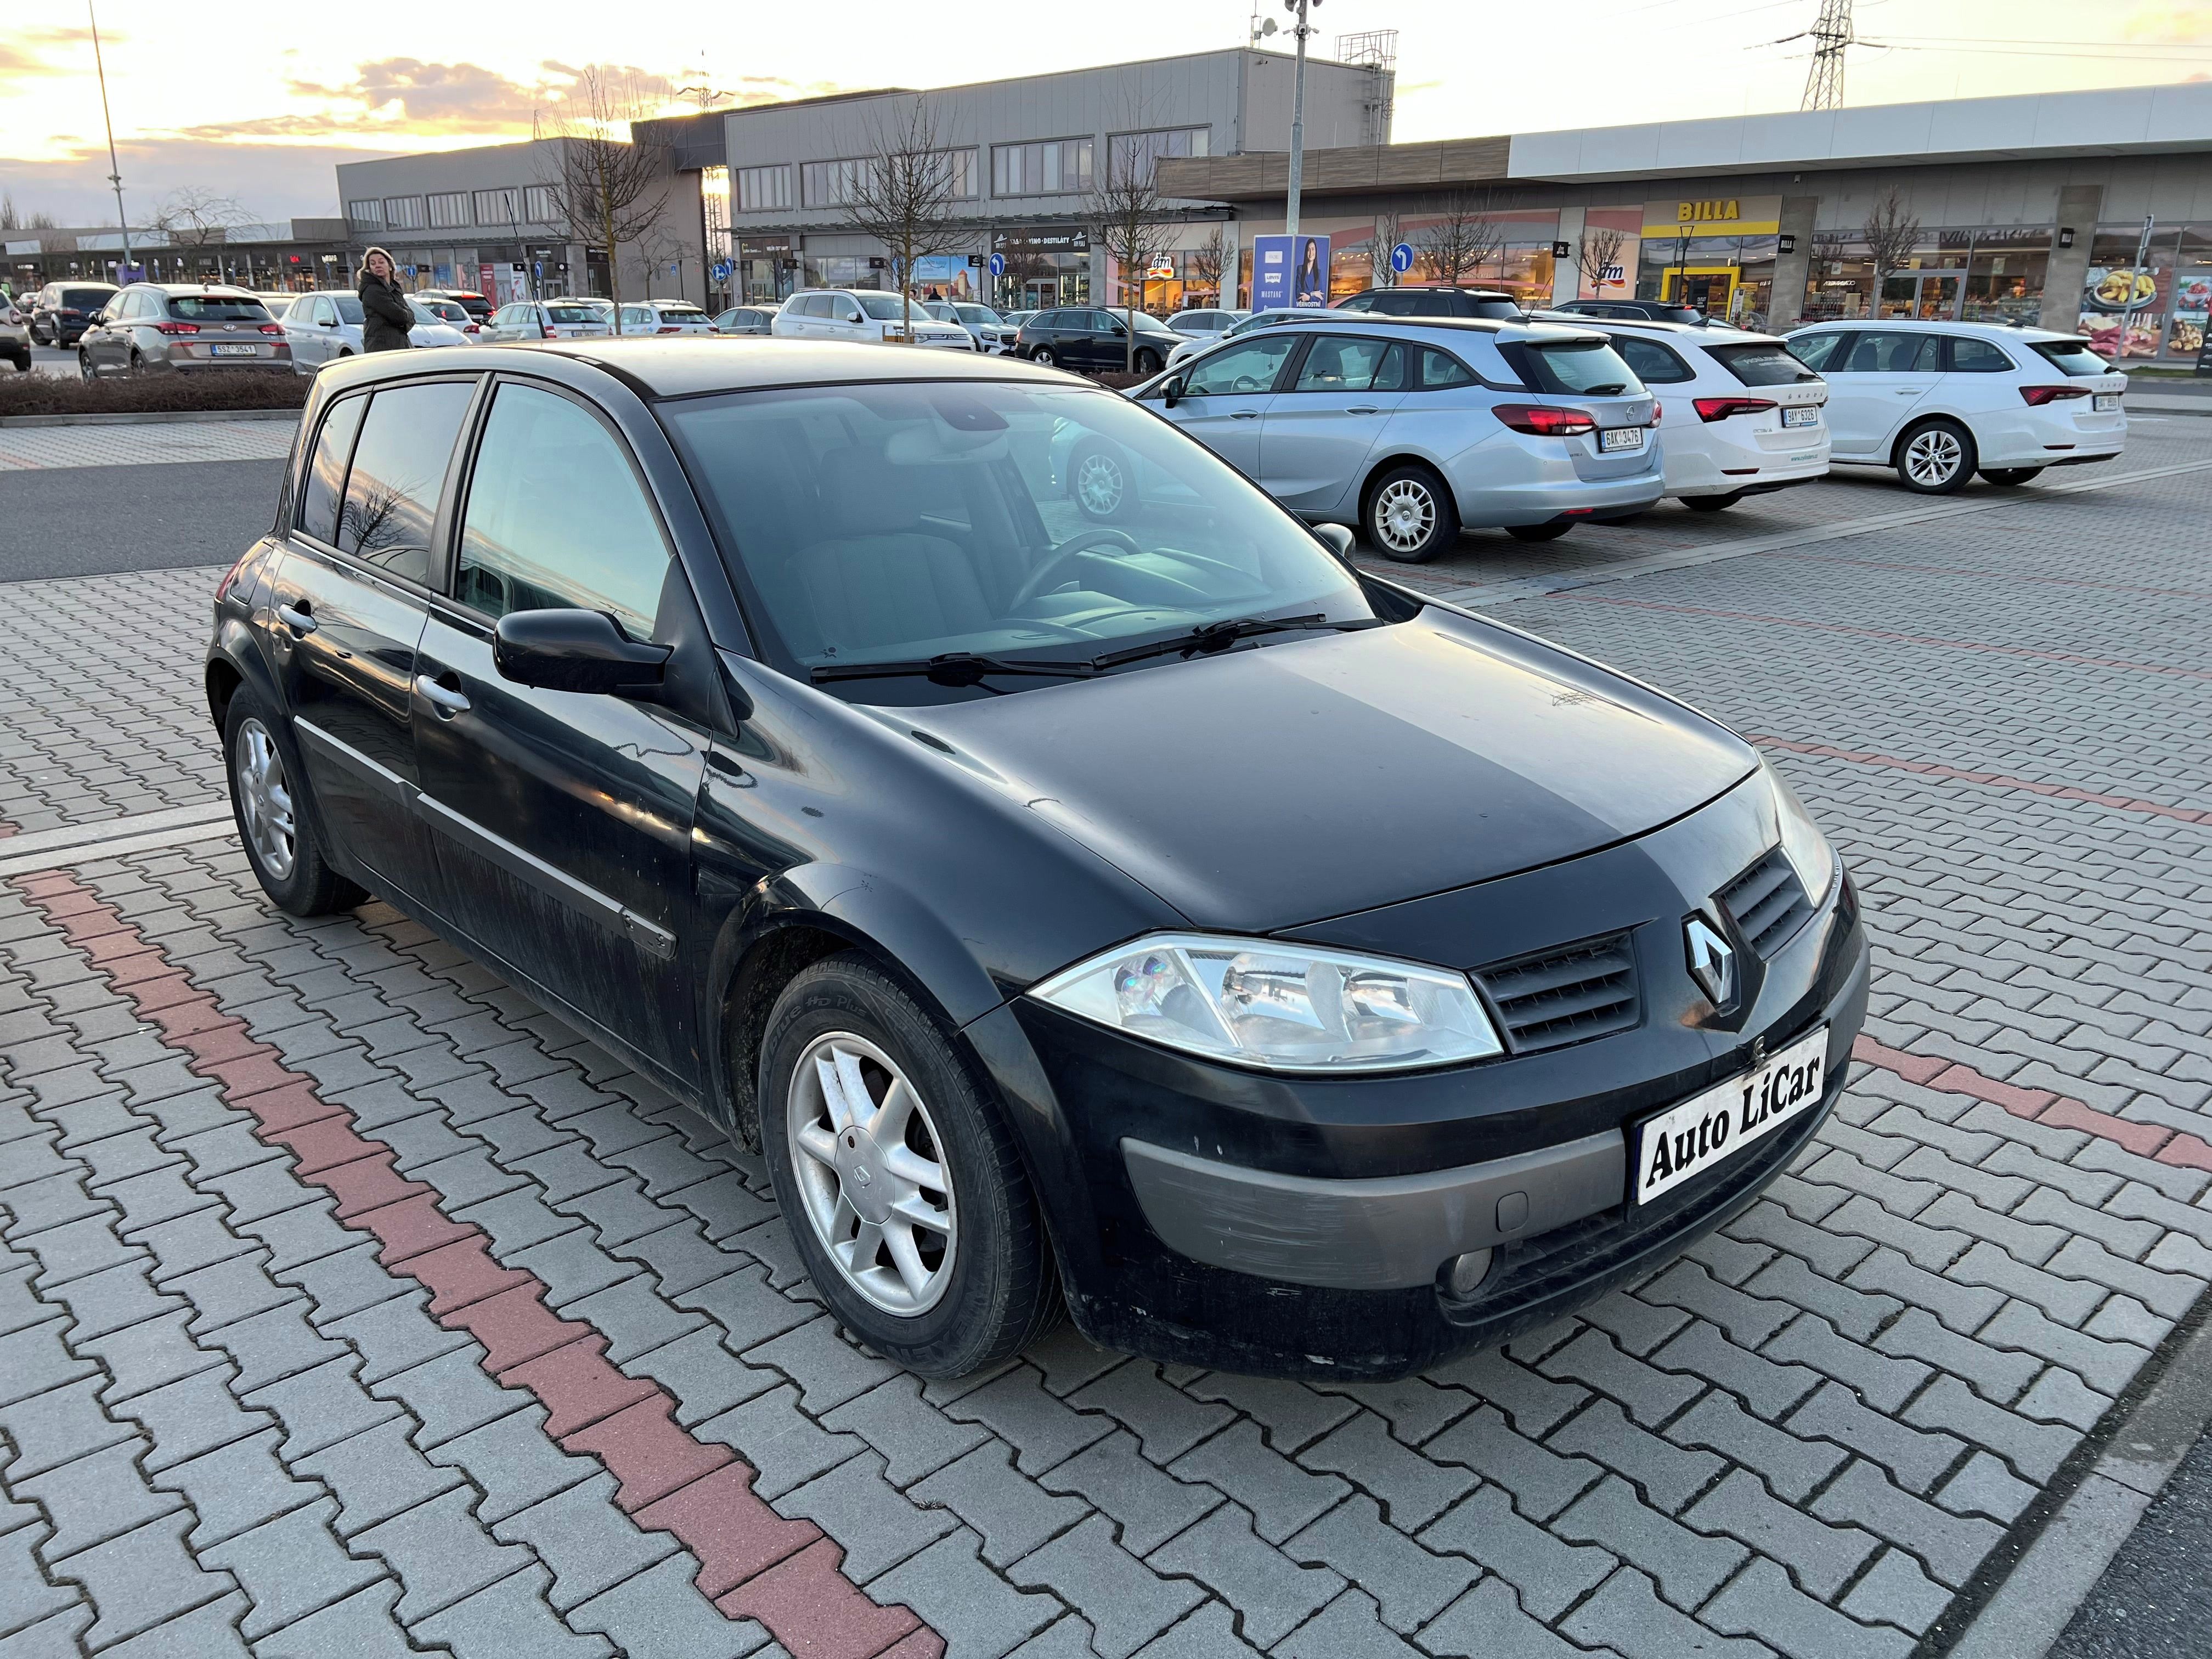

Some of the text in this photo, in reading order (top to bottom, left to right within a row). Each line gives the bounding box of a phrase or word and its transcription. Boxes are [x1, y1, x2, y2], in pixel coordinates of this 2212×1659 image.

[1678, 200, 1739, 221] BILLA
[1043, 236, 1070, 244] DESTILÁTY
[1781, 240, 1792, 249] BILLA
[1153, 253, 1170, 268] dm
[1788, 409, 1814, 422] 9AY 6326
[1606, 430, 1639, 446] 6AK 3476
[1646, 1056, 1820, 1188] Auto LiCar
